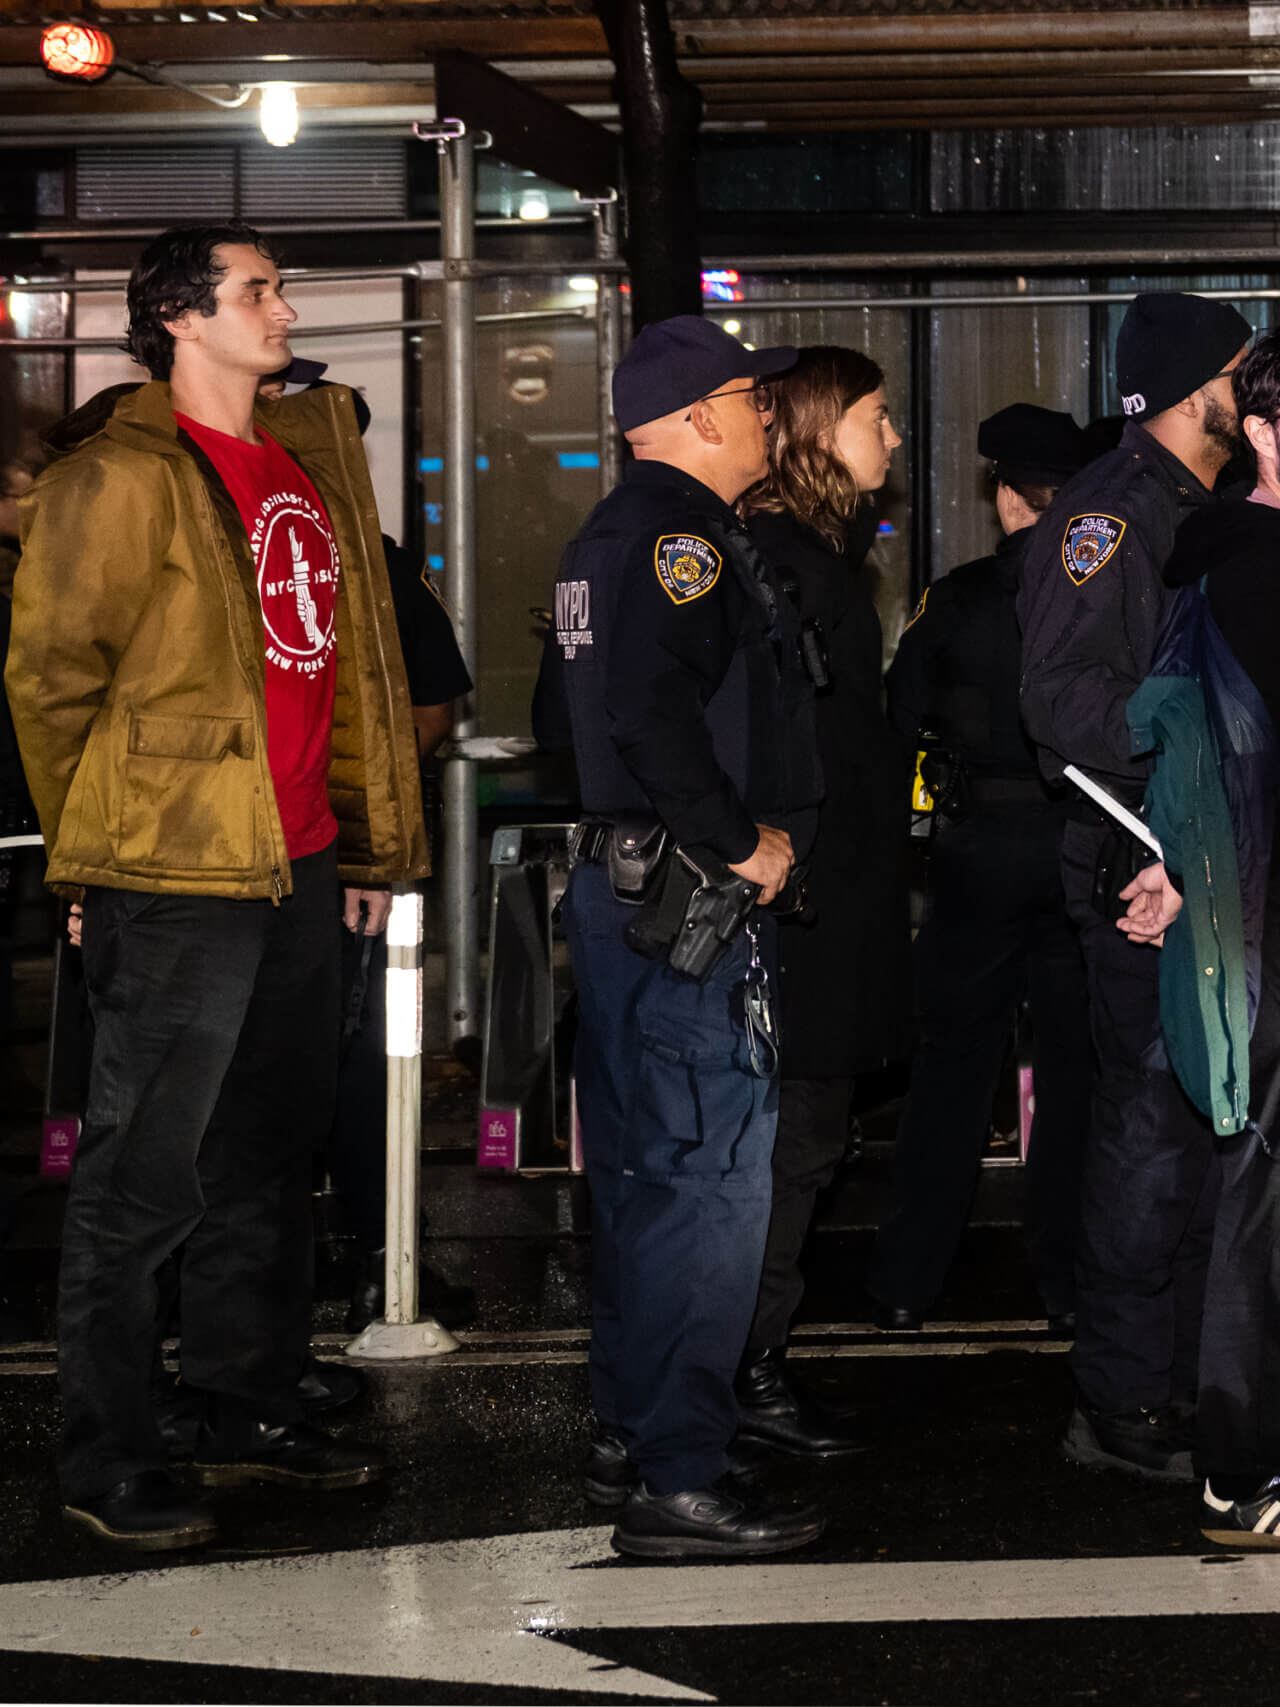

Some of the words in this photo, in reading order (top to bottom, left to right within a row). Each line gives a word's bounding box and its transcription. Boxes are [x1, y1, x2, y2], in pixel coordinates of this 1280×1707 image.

[1069, 525, 1117, 538] DEPARTMENT
[1081, 518, 1109, 528] POLICE
[677, 537, 709, 553] POLICE
[662, 544, 716, 568] DEPARTMENT
[266, 579, 295, 597] NYC
[555, 580, 590, 631] NYPD
[265, 646, 292, 670] NEW
[296, 660, 325, 673] YORK
